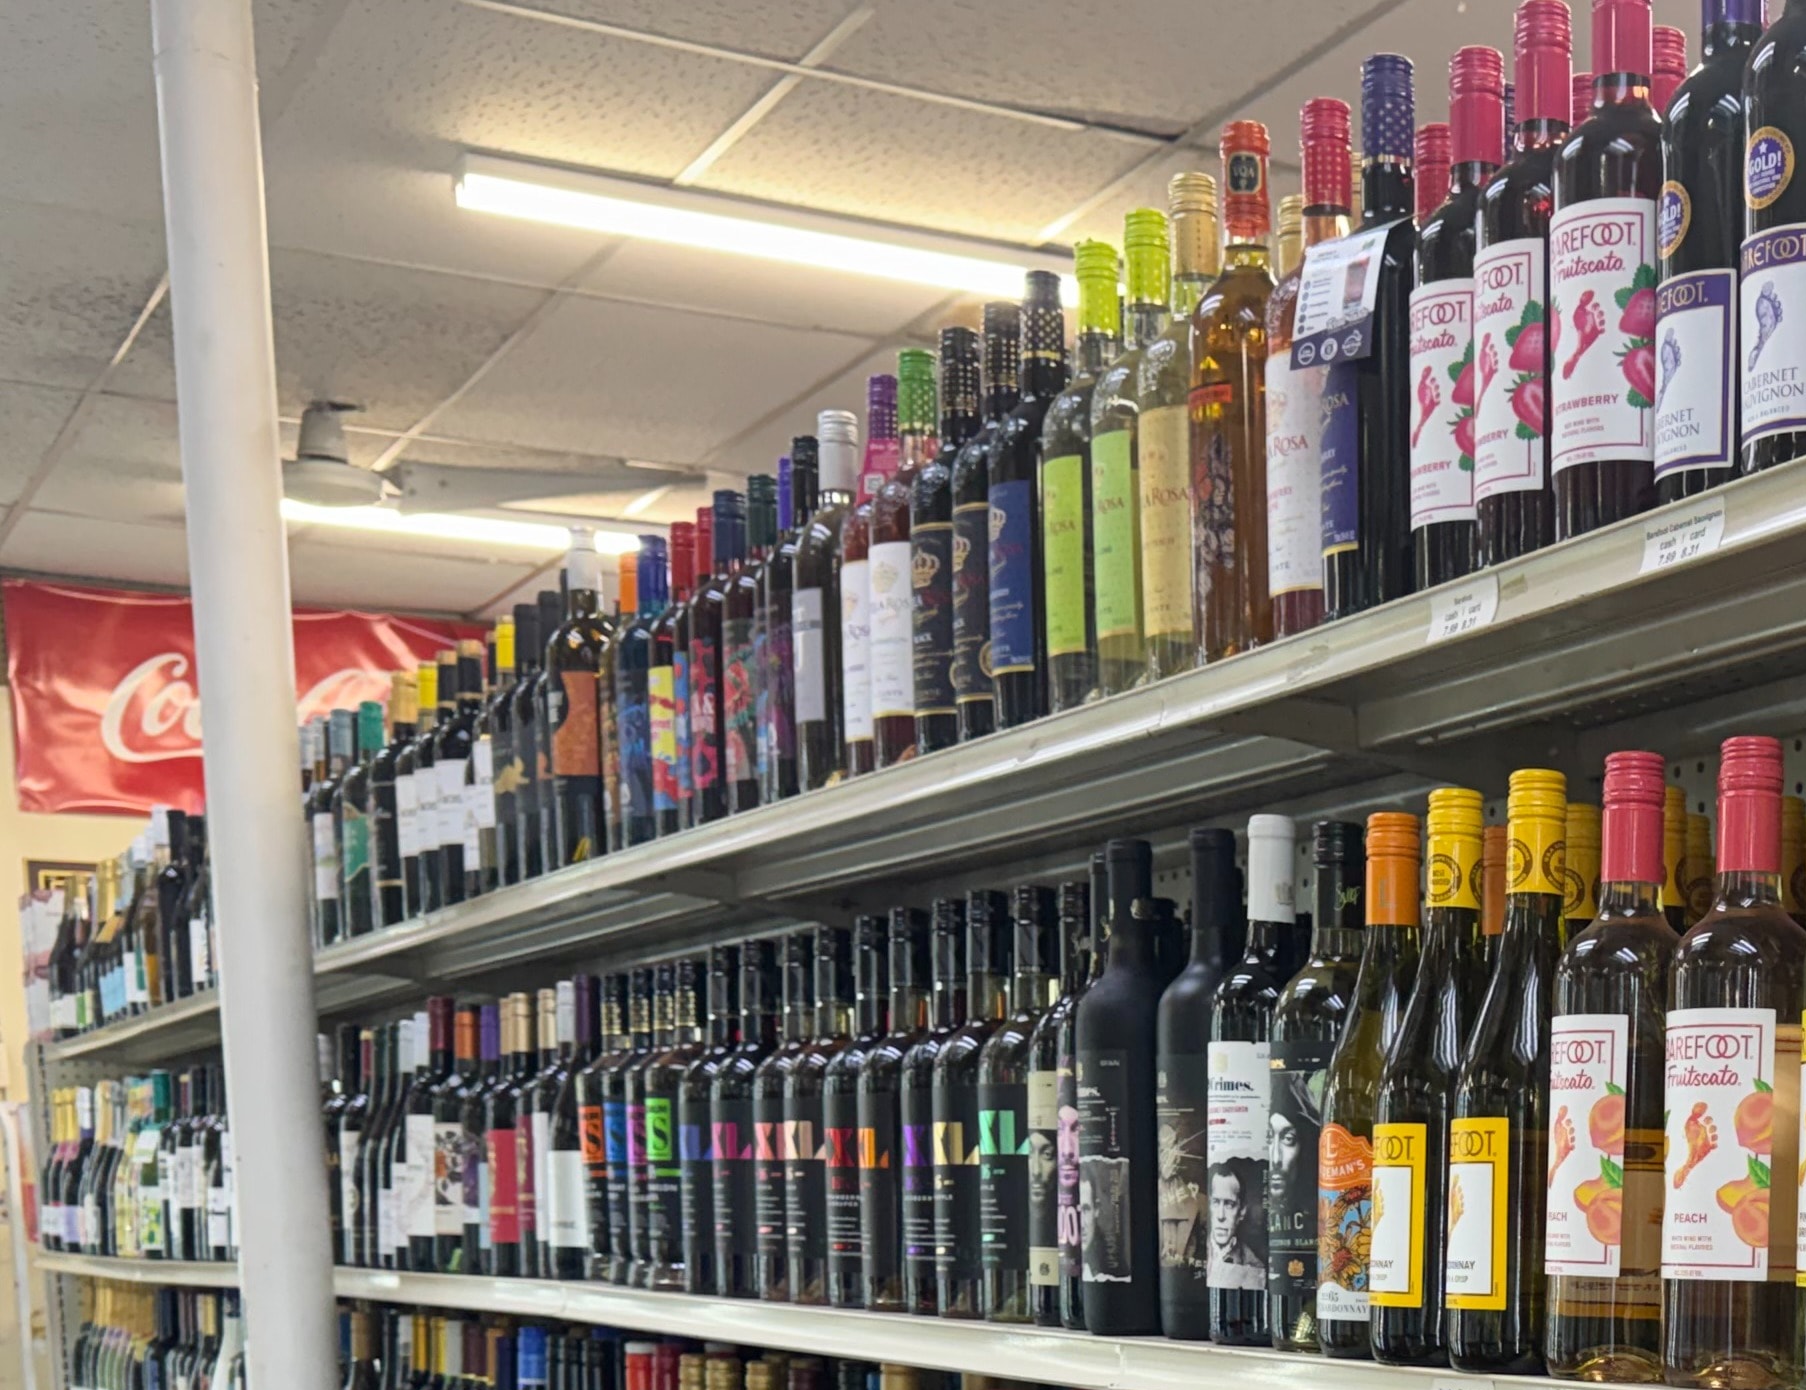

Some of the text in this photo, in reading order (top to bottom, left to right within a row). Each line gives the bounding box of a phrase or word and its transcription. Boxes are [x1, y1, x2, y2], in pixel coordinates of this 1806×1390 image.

[1750, 150, 1782, 174] GOLD!
[1556, 394, 1618, 416] STRAWBERRY
[1667, 1065, 1741, 1088] Fruitscato
[1674, 1212, 1707, 1223] PEACH
